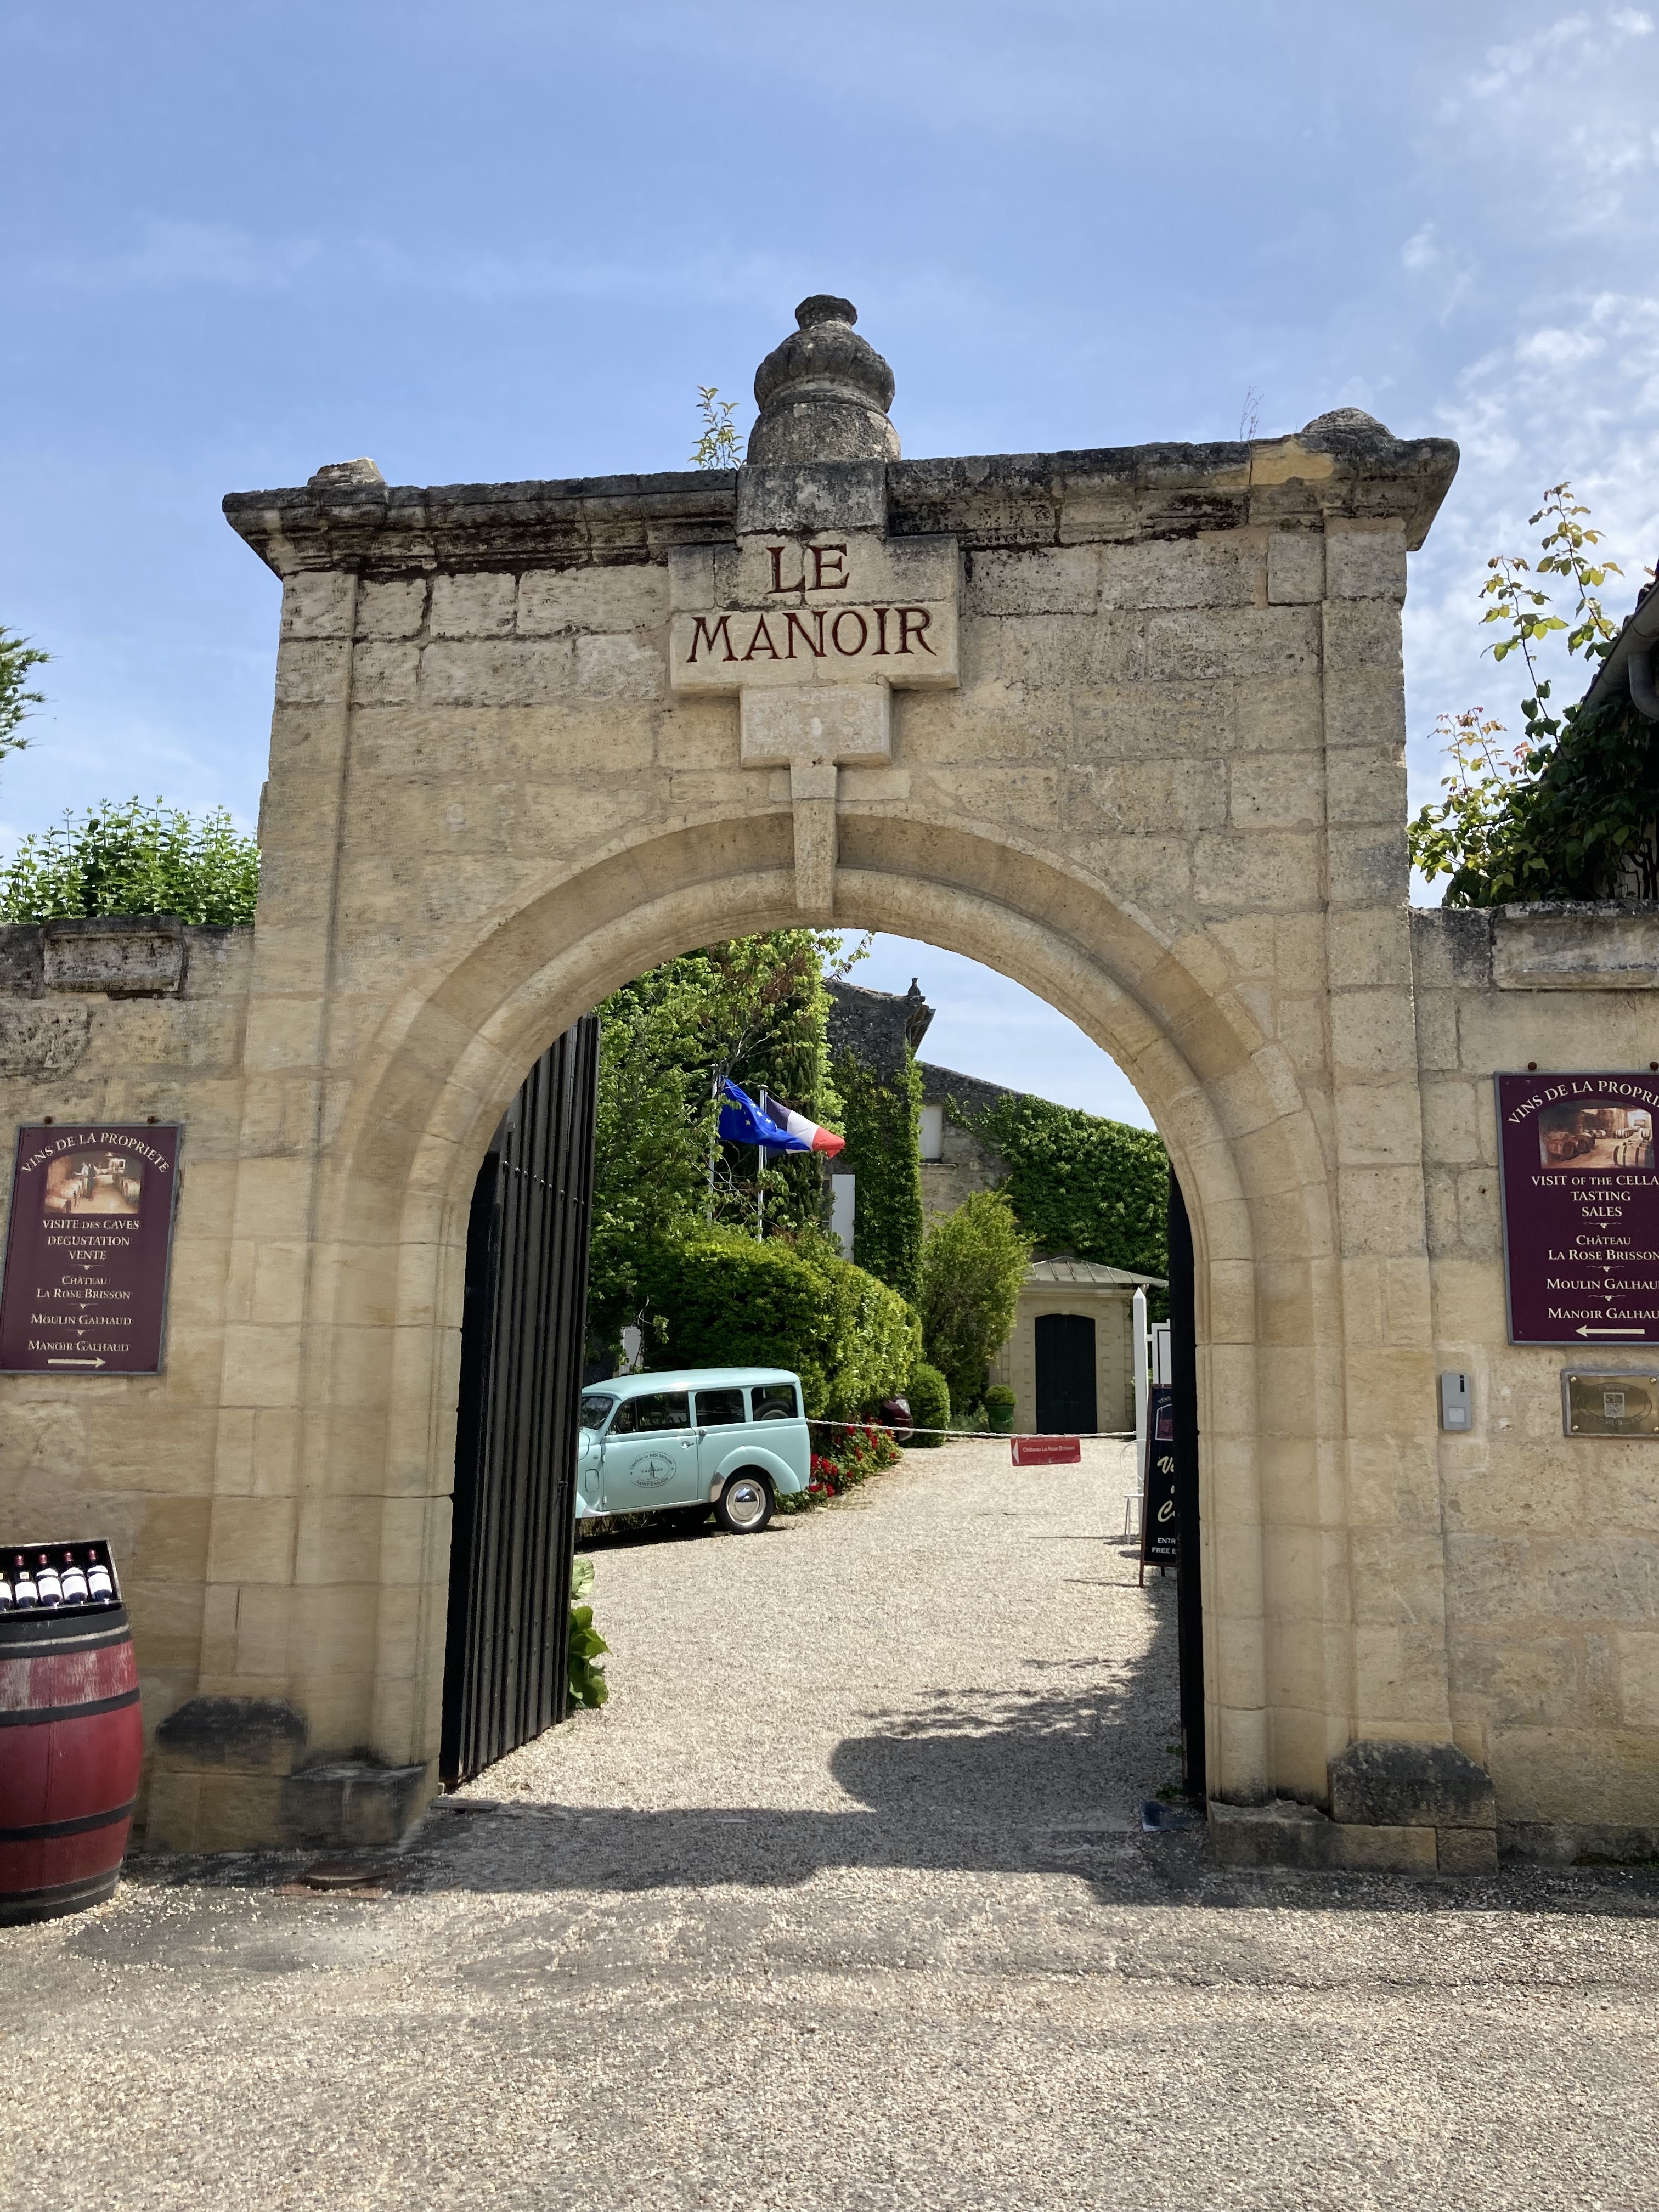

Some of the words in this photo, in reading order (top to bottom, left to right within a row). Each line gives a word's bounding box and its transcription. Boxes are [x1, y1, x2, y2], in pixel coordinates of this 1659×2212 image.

[766, 543, 850, 594] LE
[686, 607, 938, 663] MANOIR
[1508, 1095, 1543, 1124] VINS
[1544, 1085, 1568, 1101] DE
[1571, 1081, 1594, 1093] LA
[1598, 1081, 1659, 1108] PROPRI
[22, 1146, 54, 1172] VINS
[55, 1136, 75, 1151] DE
[79, 1133, 97, 1145] LA
[100, 1132, 170, 1172] PROPRIETE
[1531, 1175, 1567, 1186] VISIT
[1571, 1177, 1586, 1186] OF
[1589, 1177, 1613, 1186] THE
[1570, 1190, 1631, 1201] TASTING
[1582, 1206, 1622, 1217] SALES
[42, 1219, 80, 1229] VISITE
[82, 1221, 100, 1229] DES
[103, 1220, 140, 1229] CAVES
[47, 1235, 131, 1246] DEGUSTATION
[69, 1250, 107, 1260] VENTE
[1548, 1249, 1566, 1260] LA
[1568, 1249, 1603, 1260] ROSE
[1546, 1278, 1600, 1289] MOULIN
[1604, 1278, 1659, 1289] GALHAU
[37, 1288, 51, 1299] LA
[54, 1288, 83, 1299] ROSE
[85, 1288, 132, 1299] BRISSON
[1548, 1307, 1603, 1319] MANOIR
[31, 1313, 76, 1324] MOULIN
[78, 1314, 132, 1325] GALHAUD
[28, 1340, 74, 1351] MANOIR
[77, 1341, 130, 1352] GALHAUD
[1158, 1395, 1172, 1404] VINS
[1157, 1500, 1176, 1522] C
